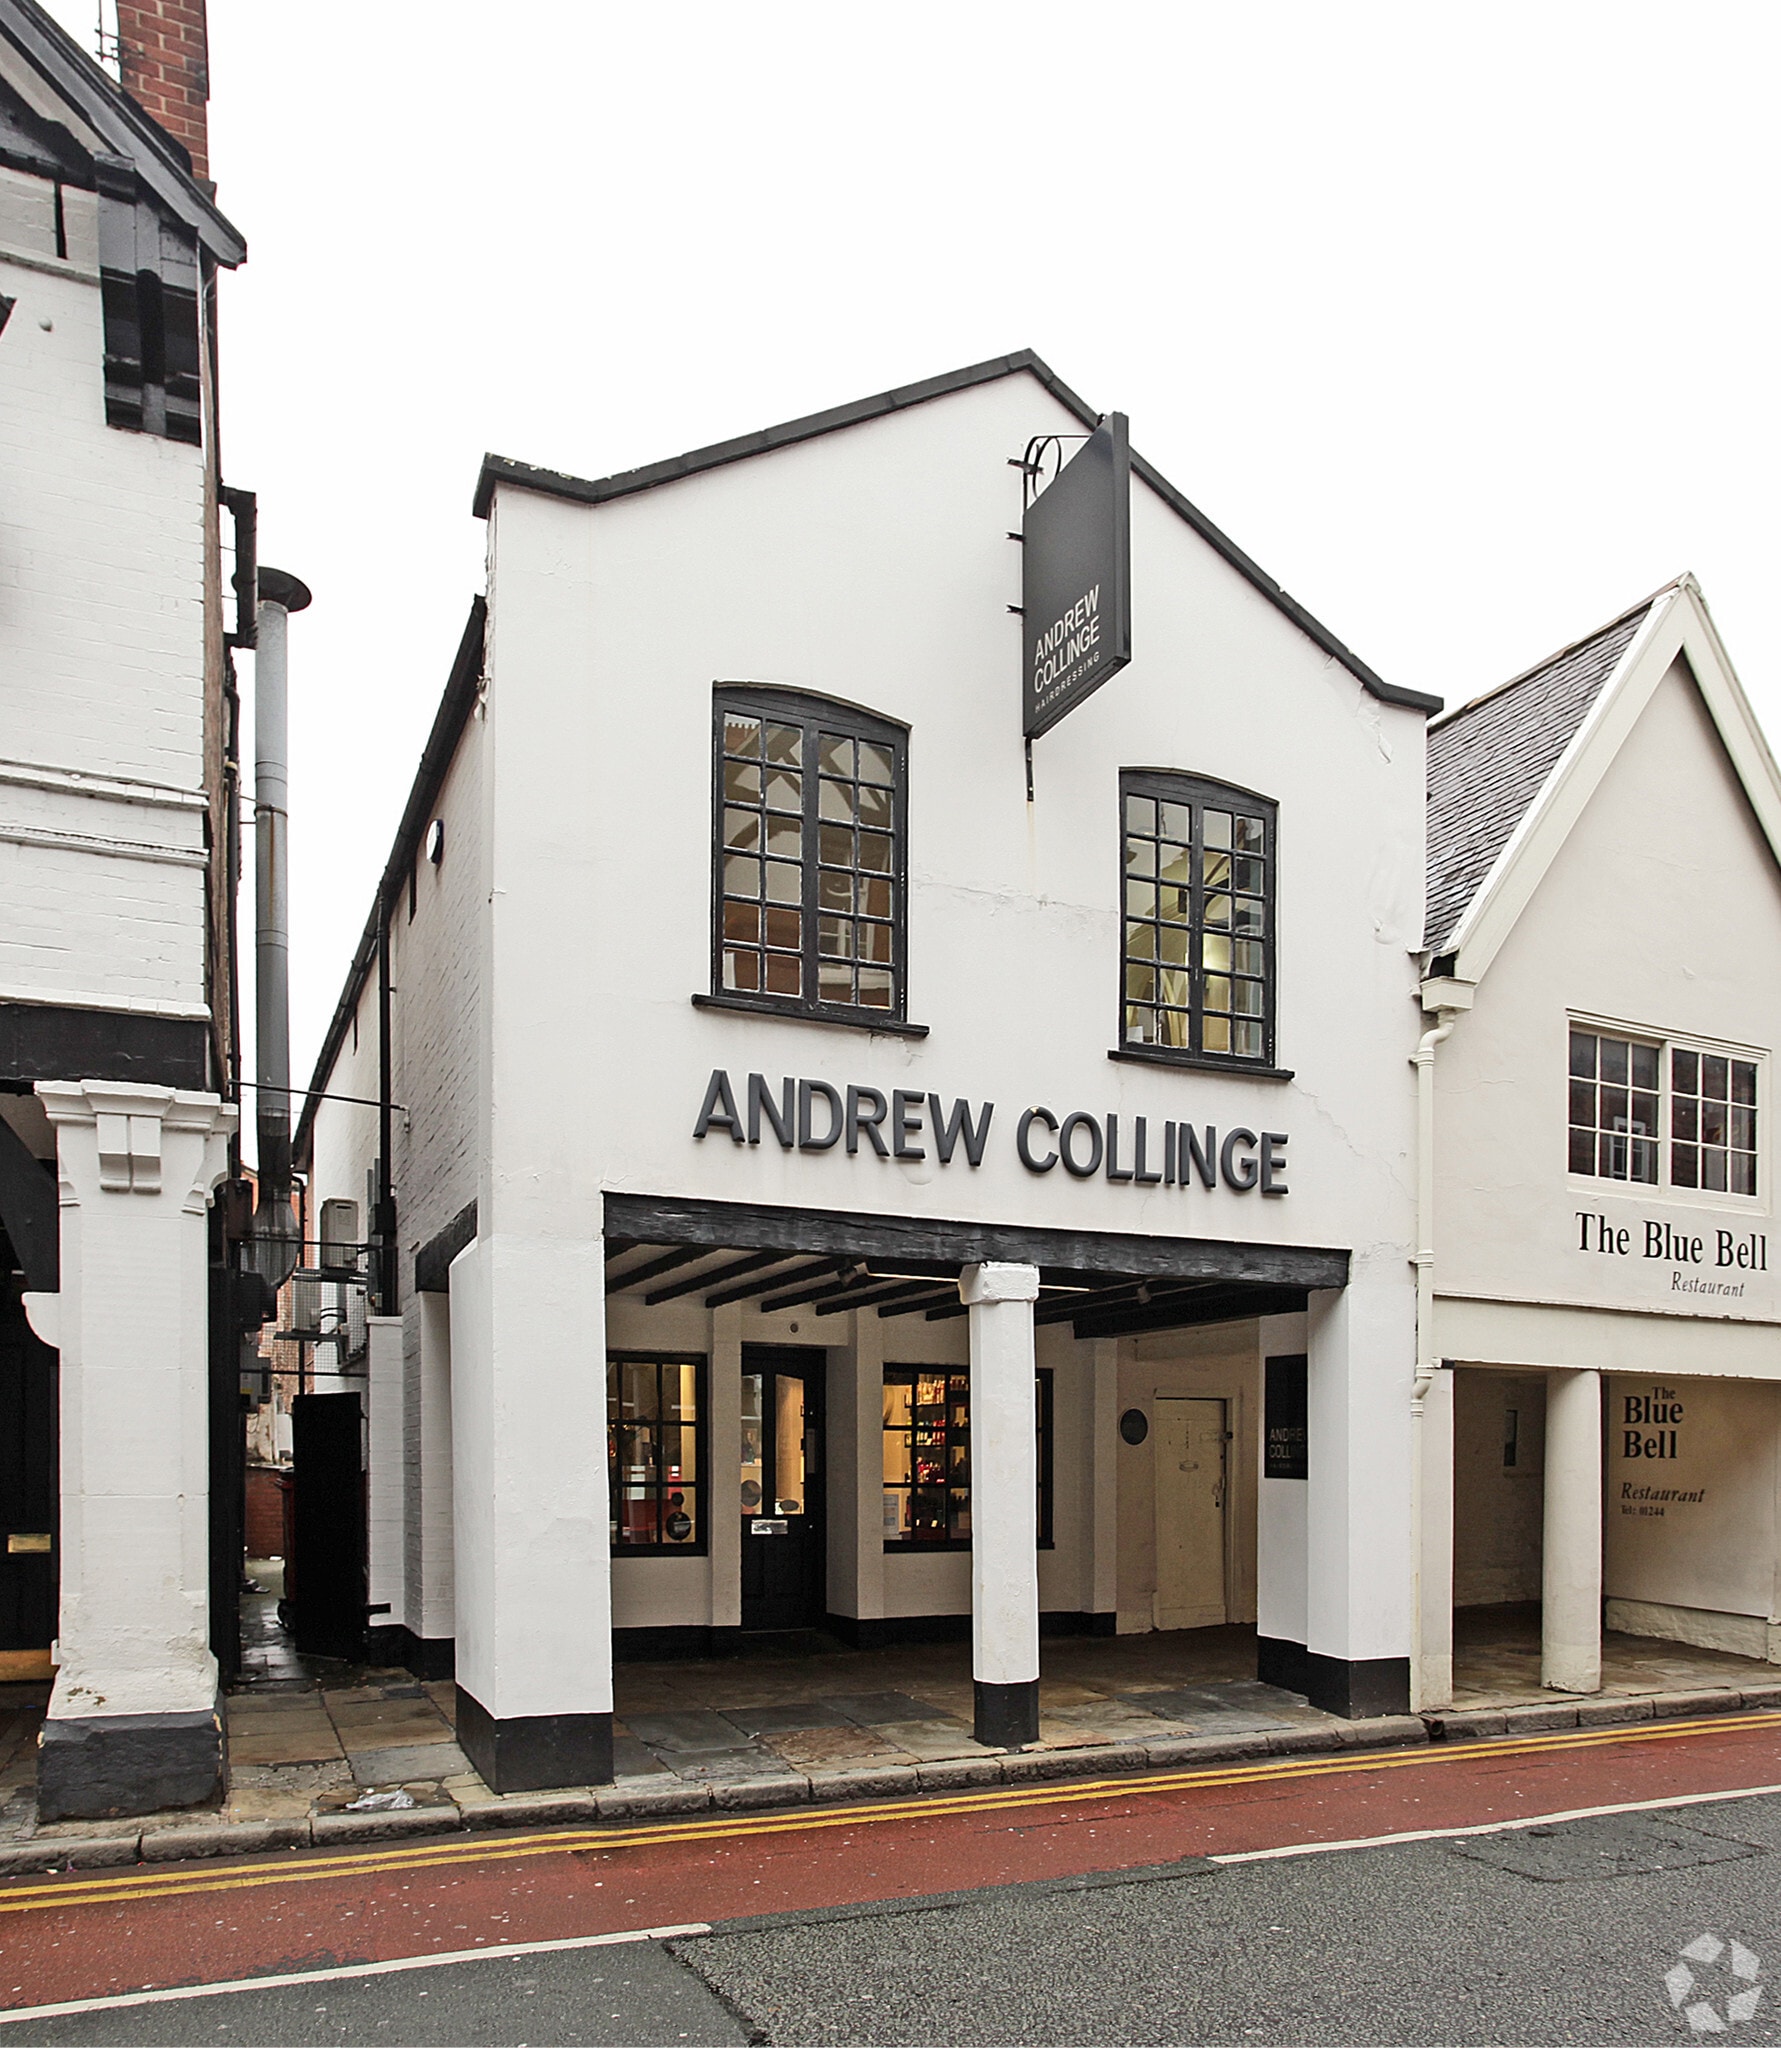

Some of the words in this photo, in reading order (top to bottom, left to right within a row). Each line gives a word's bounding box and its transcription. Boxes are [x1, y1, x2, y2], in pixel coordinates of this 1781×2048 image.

[1034, 584, 1100, 666] ANDREW
[1034, 615, 1100, 693] COLLINGE
[1034, 651, 1100, 714] HAIRDRESSING
[692, 1068, 996, 1168] ANDREW
[1016, 1105, 1290, 1197] COLLINGE
[1574, 1212, 1630, 1255] The
[1642, 1220, 1703, 1264] Blue
[1714, 1229, 1768, 1271] Bell
[1671, 1271, 1745, 1297] Restaurant
[1652, 1386, 1676, 1400] The
[1623, 1395, 1684, 1424] Blue
[1269, 1427, 1305, 1442] ANDRE
[1622, 1430, 1678, 1459] Bell
[1621, 1482, 1706, 1503] Restaurant
[1638, 1505, 1665, 1517] 01244
